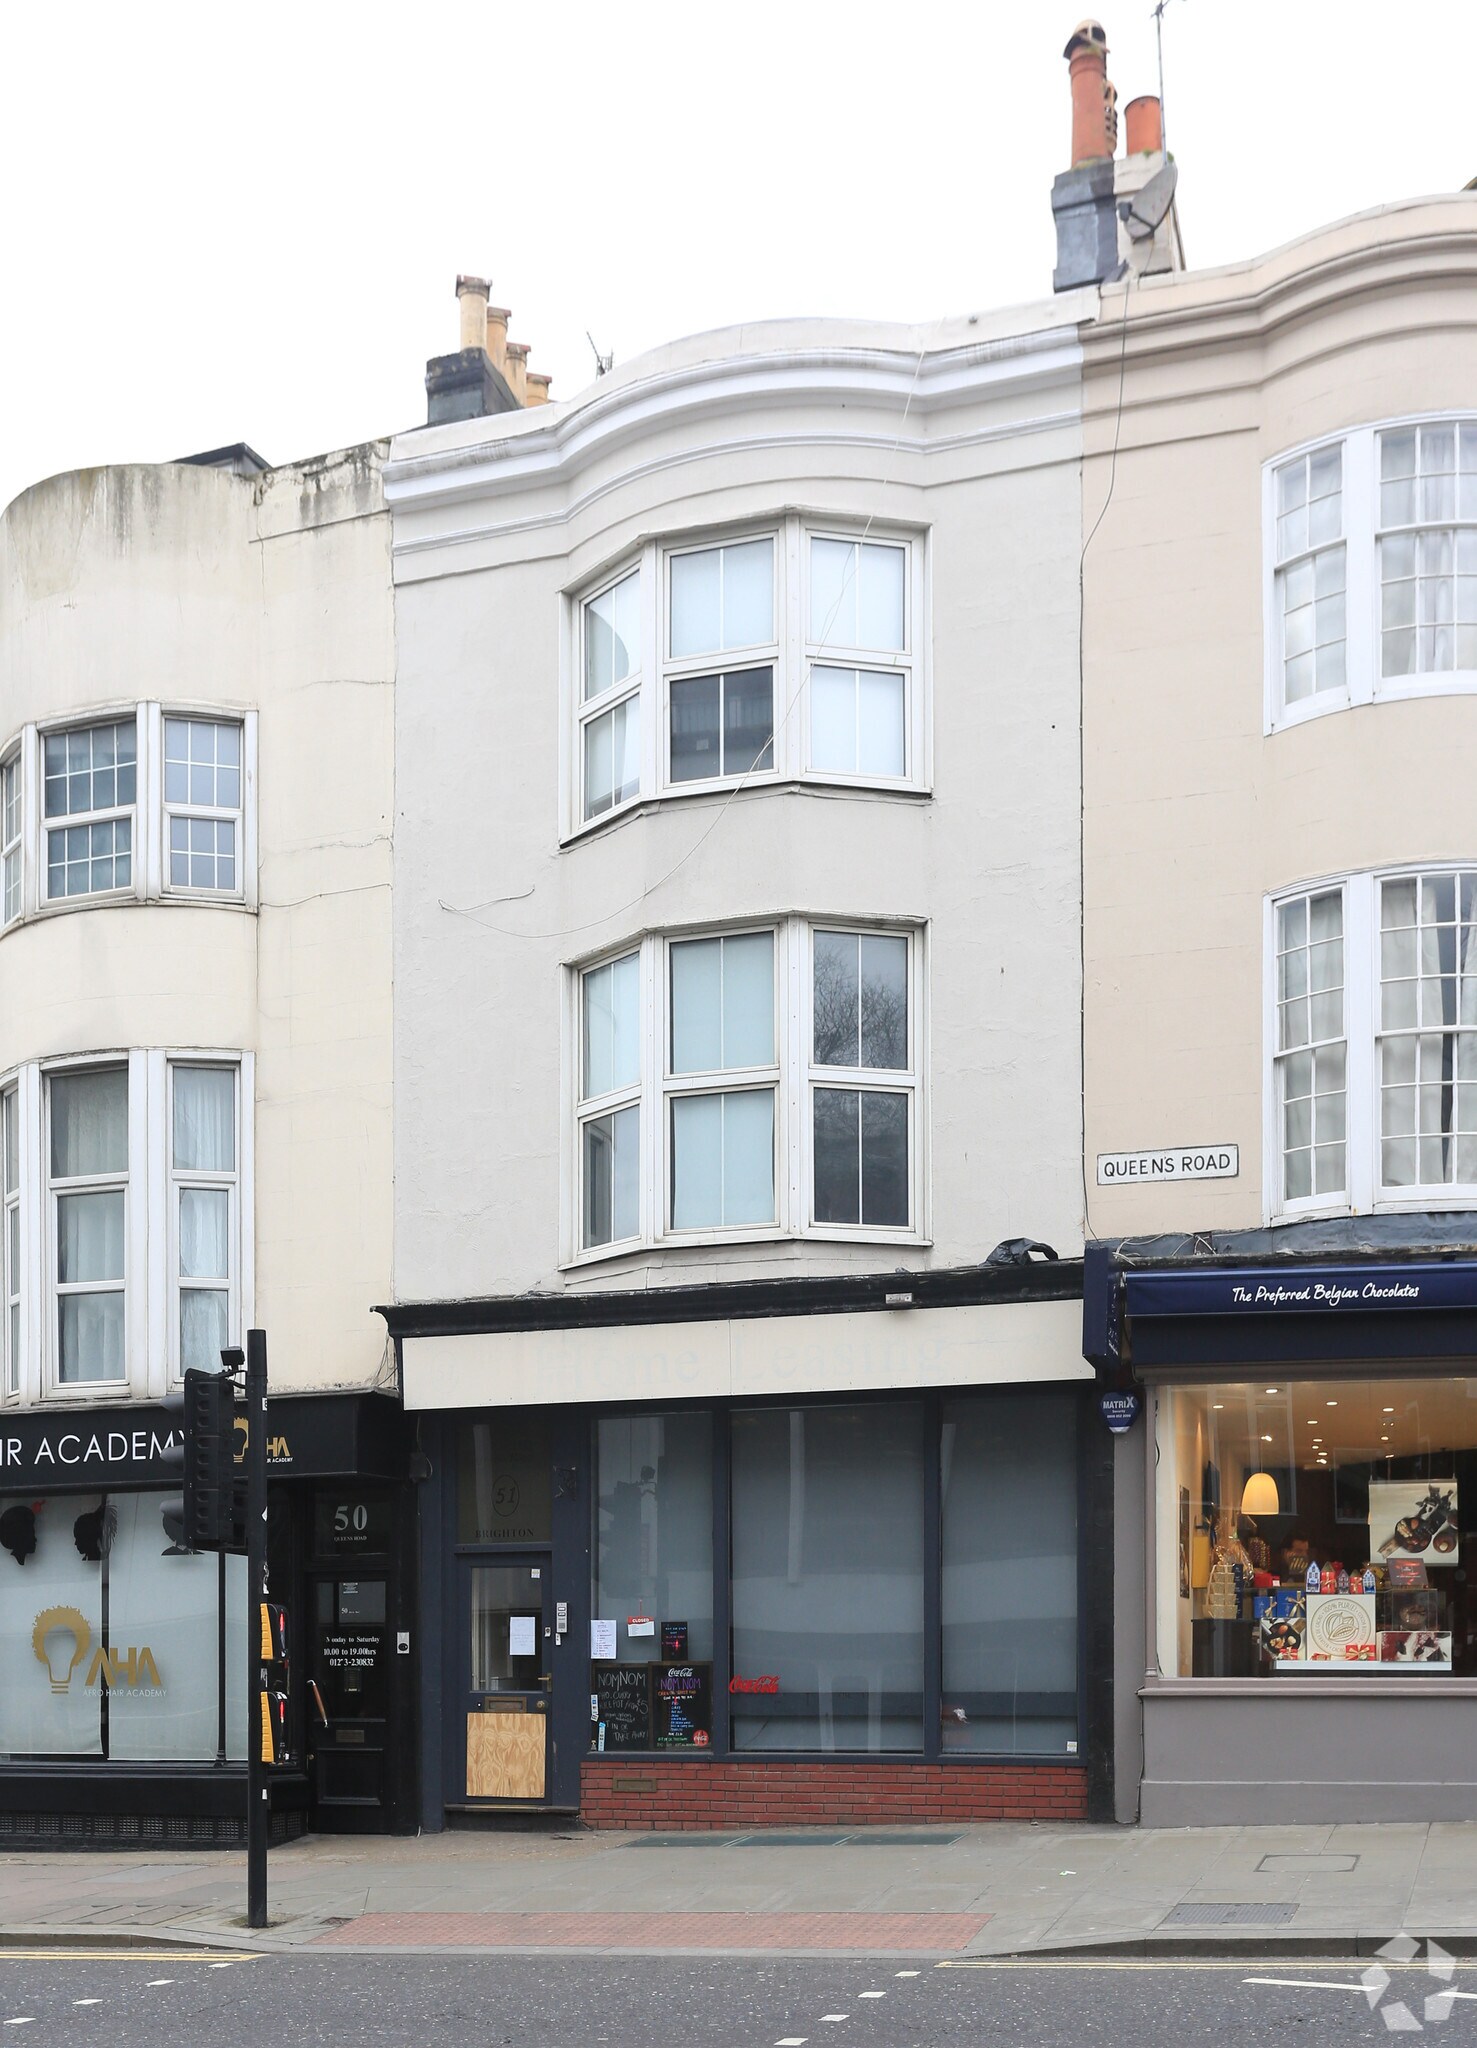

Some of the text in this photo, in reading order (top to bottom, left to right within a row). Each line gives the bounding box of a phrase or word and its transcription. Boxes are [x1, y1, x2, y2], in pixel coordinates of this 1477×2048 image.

[1182, 1153, 1231, 1172] ROAD
[1233, 1282, 1420, 1306] The Preferred Belgian Chocolates
[1102, 1396, 1135, 1409] MATRIX
[34, 1431, 184, 1465] ACADEM
[495, 1486, 516, 1505] 51
[334, 1504, 368, 1531] 50
[475, 1528, 535, 1539] BRIGHTON
[356, 1636, 380, 1644] Saturday
[341, 1648, 348, 1656] to
[660, 1677, 701, 1690] NOM NOM
[105, 1688, 125, 1698] HAIR
[126, 1688, 168, 1698] ACADEMY
